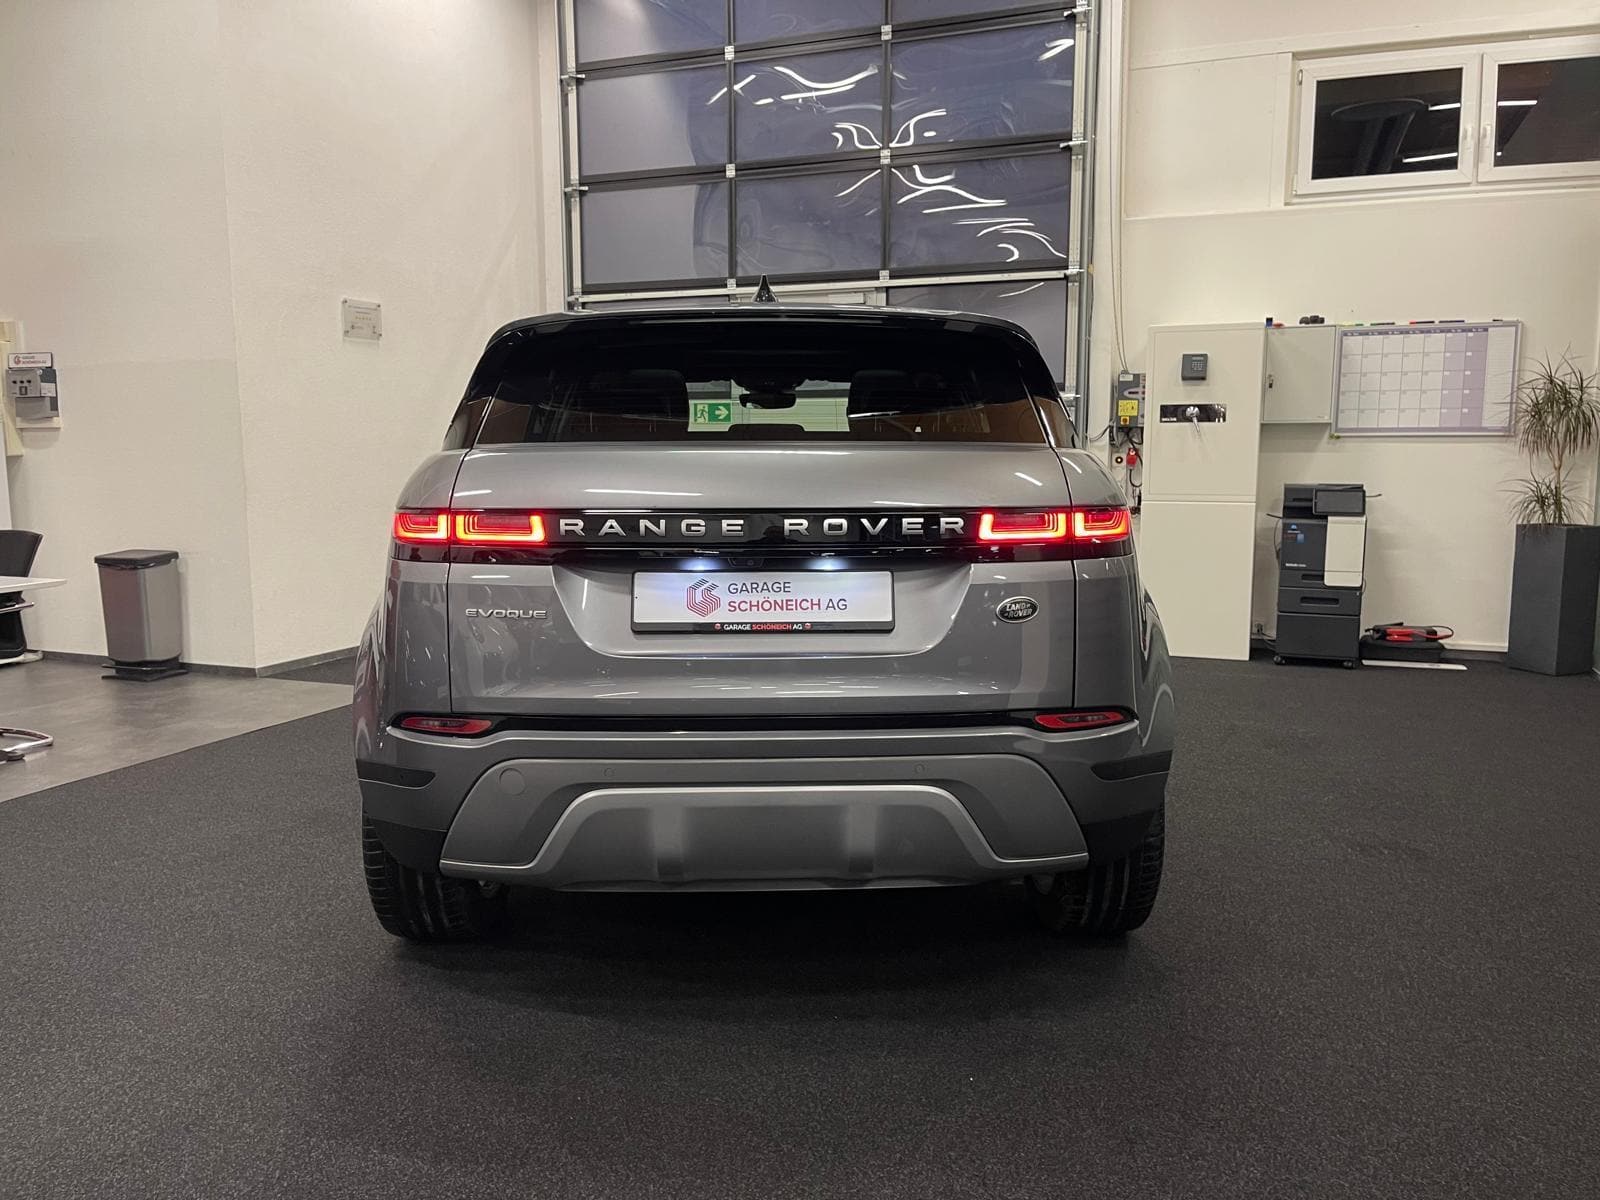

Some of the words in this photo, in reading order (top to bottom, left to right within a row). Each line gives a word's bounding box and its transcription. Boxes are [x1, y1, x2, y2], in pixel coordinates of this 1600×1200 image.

[559, 518, 744, 537] RANGE
[783, 517, 965, 536] ROVER
[727, 581, 792, 595] GARAGE
[727, 596, 821, 613] SCHÖNEICH
[825, 598, 848, 611] AG
[1006, 603, 1026, 611] LAND
[465, 608, 547, 620] EVOQUE
